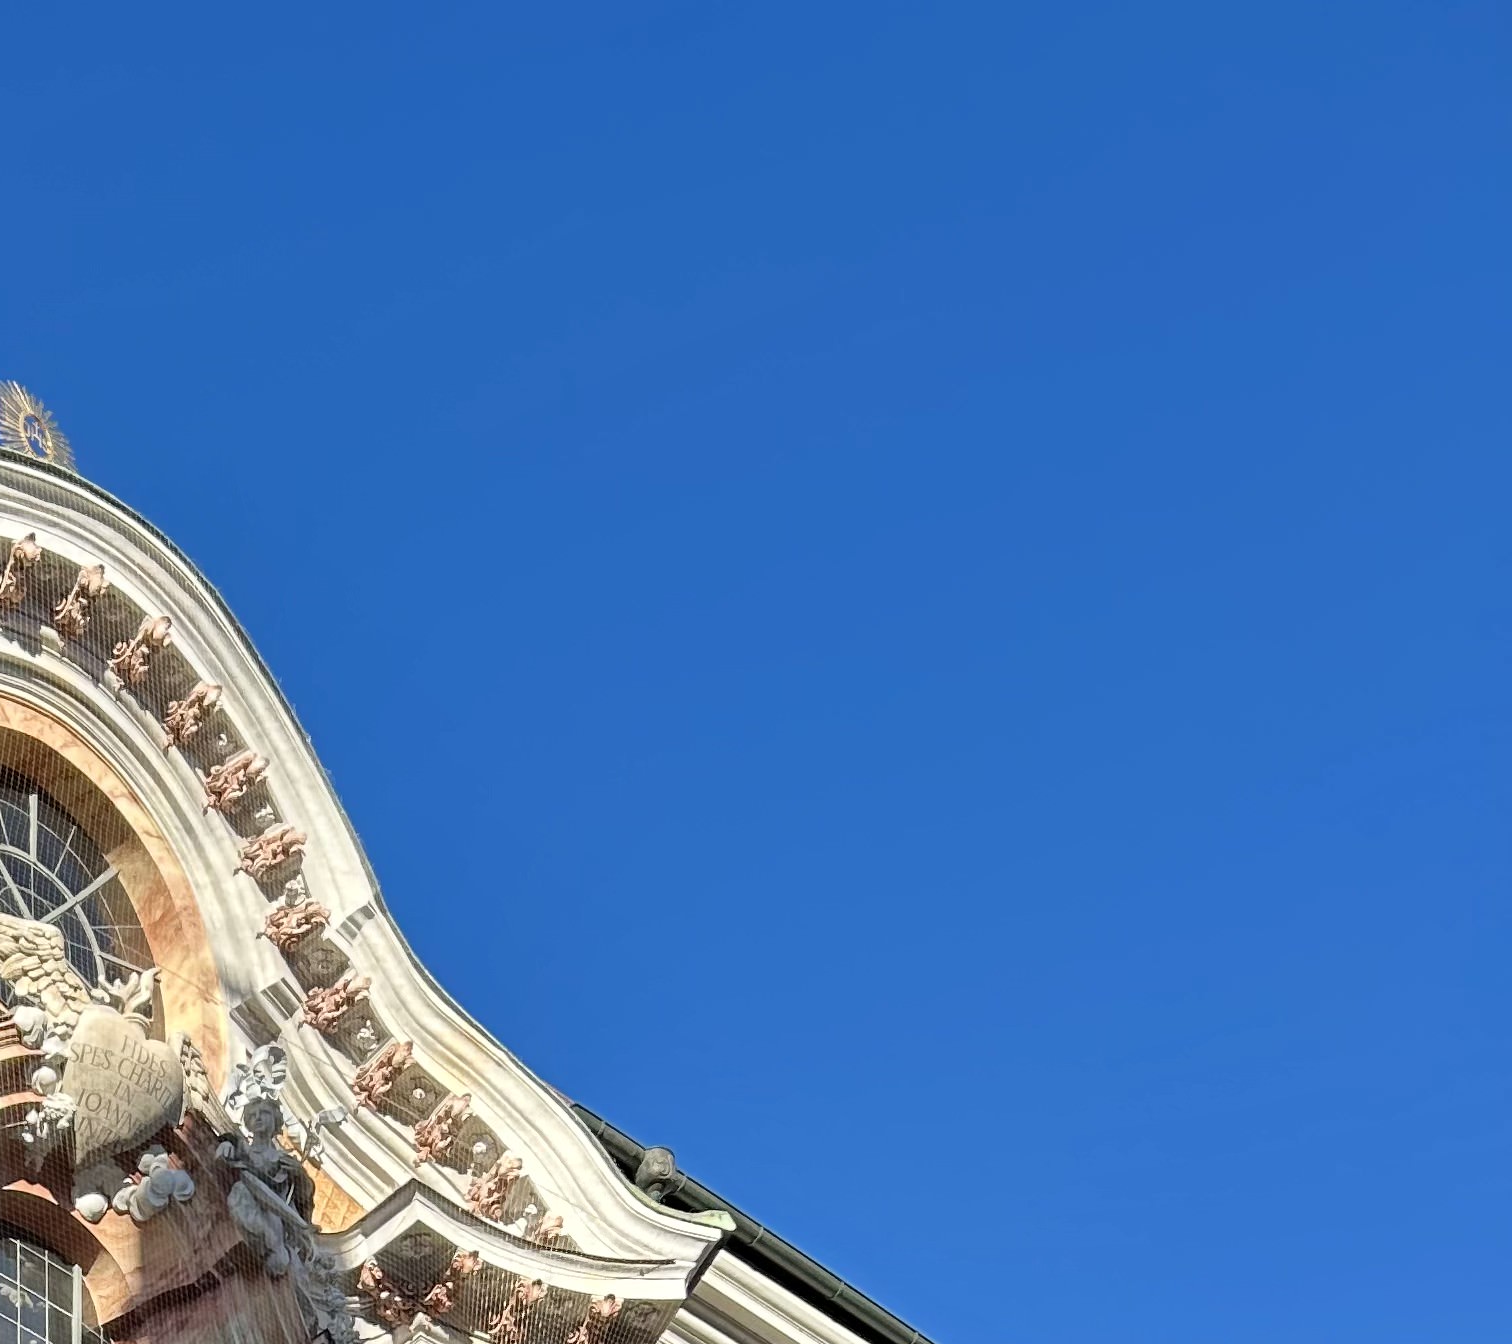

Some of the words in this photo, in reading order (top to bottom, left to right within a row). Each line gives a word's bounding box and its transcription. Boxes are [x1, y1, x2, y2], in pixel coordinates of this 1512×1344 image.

[70, 1042, 113, 1070] SPES
[121, 1035, 168, 1078] FIDES
[113, 1080, 134, 1106] IN
